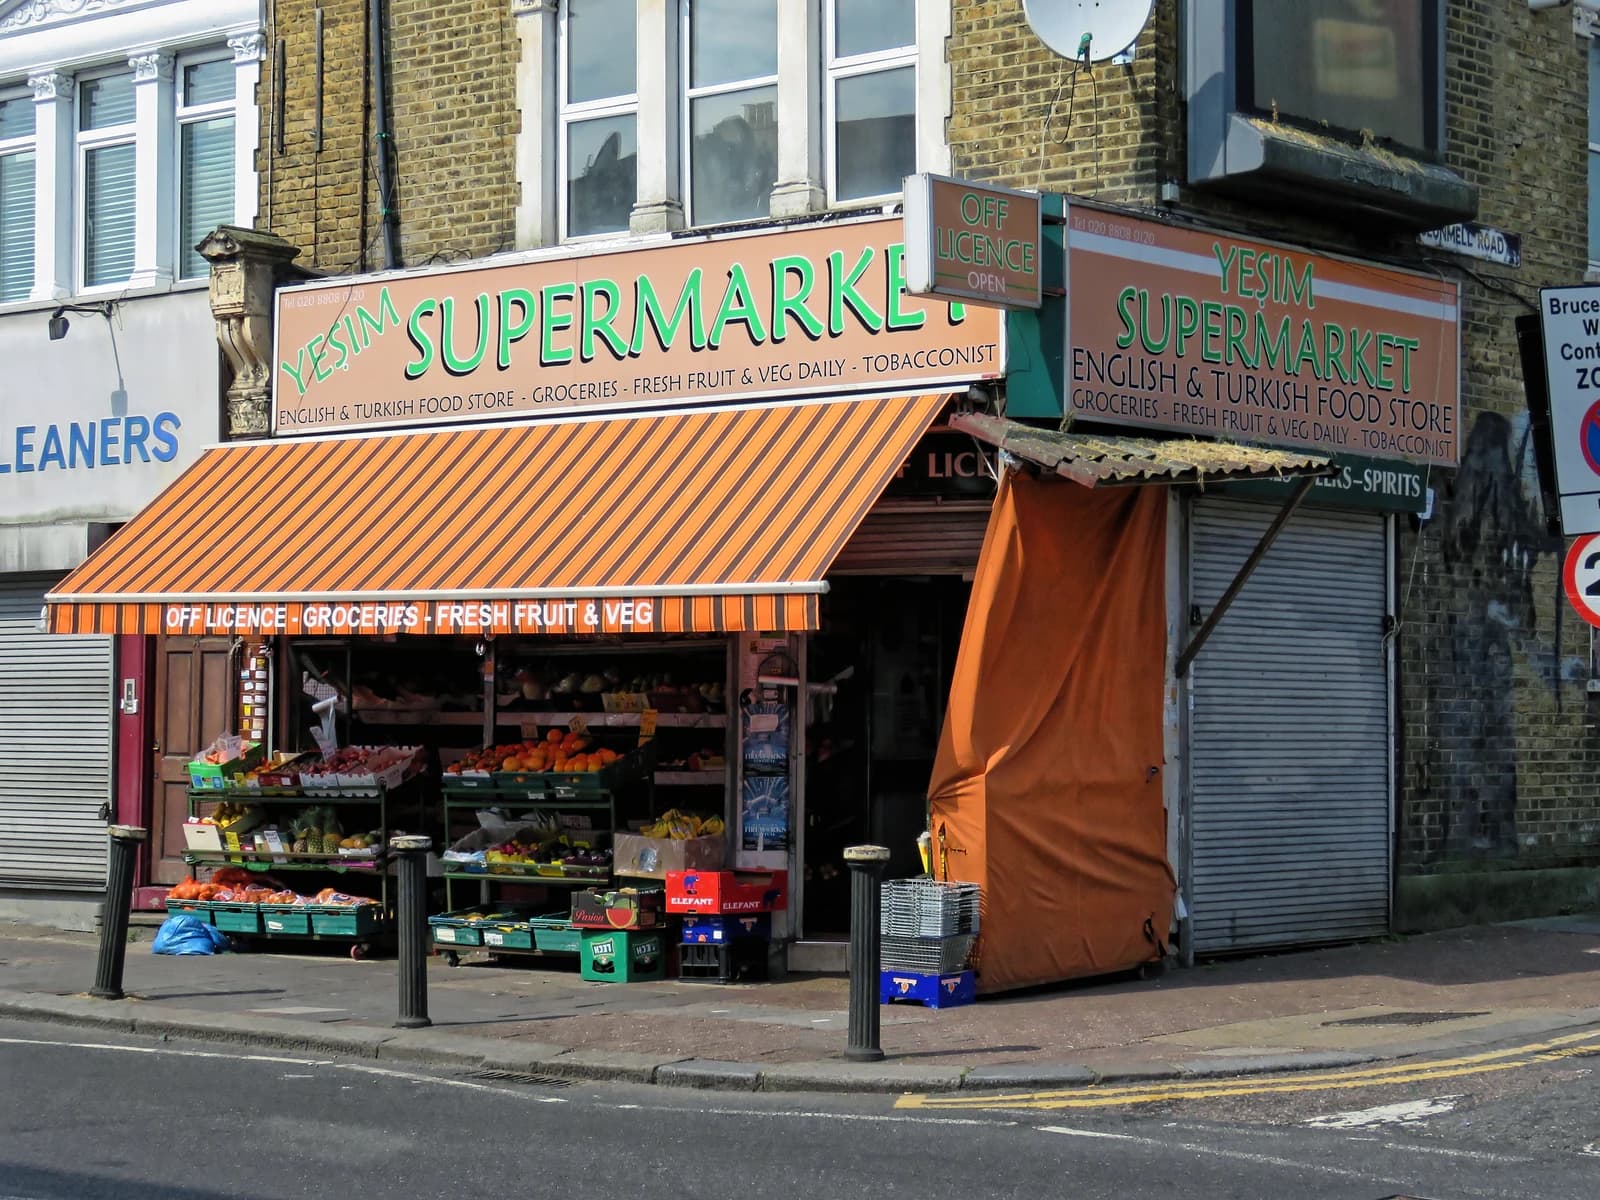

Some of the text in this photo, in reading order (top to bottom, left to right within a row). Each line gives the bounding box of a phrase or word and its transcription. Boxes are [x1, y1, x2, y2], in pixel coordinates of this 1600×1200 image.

[961, 192, 1009, 231] OFF
[1088, 220, 1106, 234] 020
[936, 226, 1035, 273] LICENCE
[1477, 231, 1504, 254] ROAD
[967, 271, 1006, 293] OPEN
[403, 242, 967, 380] SUPERMARKE
[1549, 297, 1600, 315] Bruce
[1116, 286, 1420, 393] SUPERMARKET
[279, 406, 335, 425] ENGLISH
[339, 405, 350, 421] &
[354, 400, 414, 419] TURKISH
[419, 395, 463, 414] FOOD
[467, 390, 514, 410] STORE
[532, 380, 618, 403] GROCERIES
[633, 374, 681, 395] FRESH
[688, 369, 736, 389] FRUIT
[741, 367, 753, 385] &
[758, 363, 792, 383] VEG
[799, 358, 846, 380] DAILY
[863, 344, 997, 373] TOBACCONIST
[1072, 348, 1452, 434] ENGLISH & TURKISH FOOD STORE
[1072, 388, 1159, 419] GROCERIES
[1173, 402, 1217, 426] FRESH
[1222, 409, 1263, 433] FRUIT
[1267, 416, 1278, 435] &
[1281, 417, 1309, 440] VEG
[1313, 422, 1349, 445] DAILY
[1361, 429, 1452, 458] TOBACCONIST
[928, 452, 999, 478] LICE
[166, 607, 202, 628] OFF
[205, 607, 286, 628] LICENCE
[303, 605, 419, 628] GROCERIES
[437, 605, 508, 627] FRESH
[514, 604, 577, 626] FRUIT
[583, 603, 599, 625] &
[605, 602, 653, 625] VEG
[671, 897, 714, 906] ELEFANT
[722, 901, 760, 910] ELEFANT
